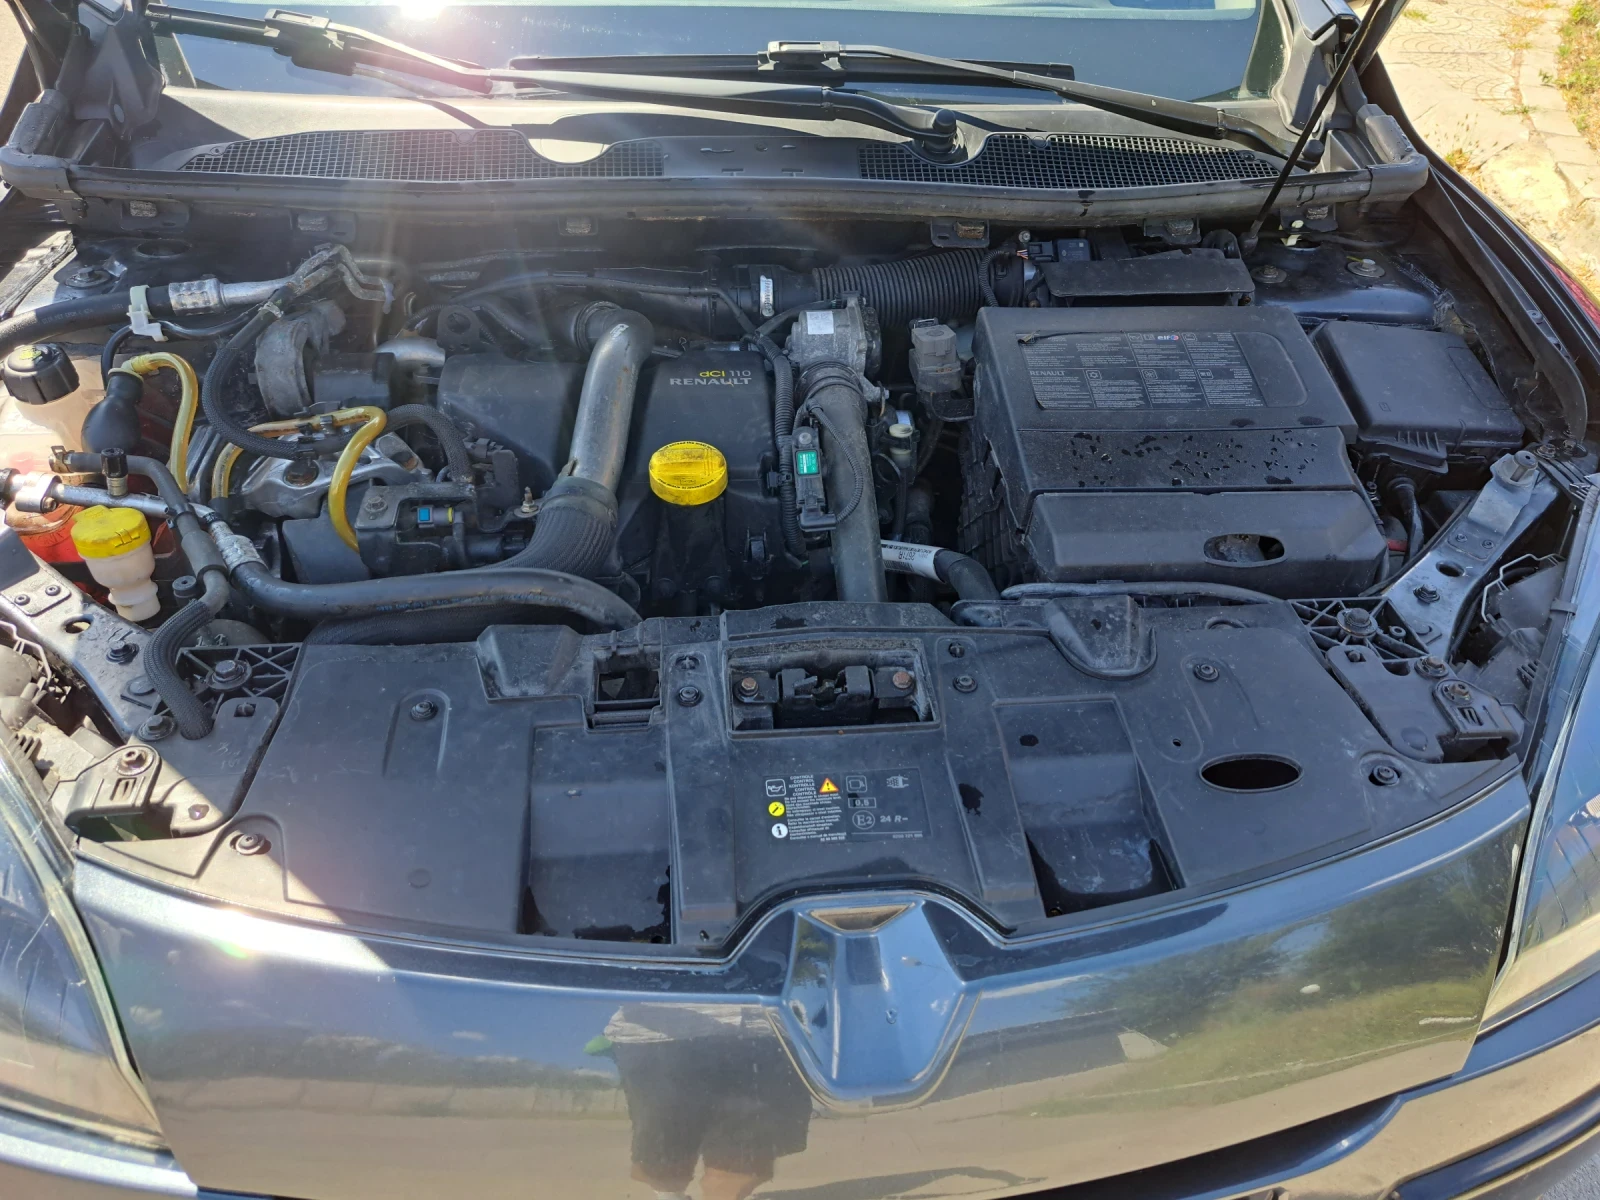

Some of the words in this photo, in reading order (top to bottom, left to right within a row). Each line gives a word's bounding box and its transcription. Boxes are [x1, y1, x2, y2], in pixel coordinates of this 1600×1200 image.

[669, 377, 752, 386] RENAULT
[856, 814, 873, 826] E2
[880, 815, 891, 823] 24
